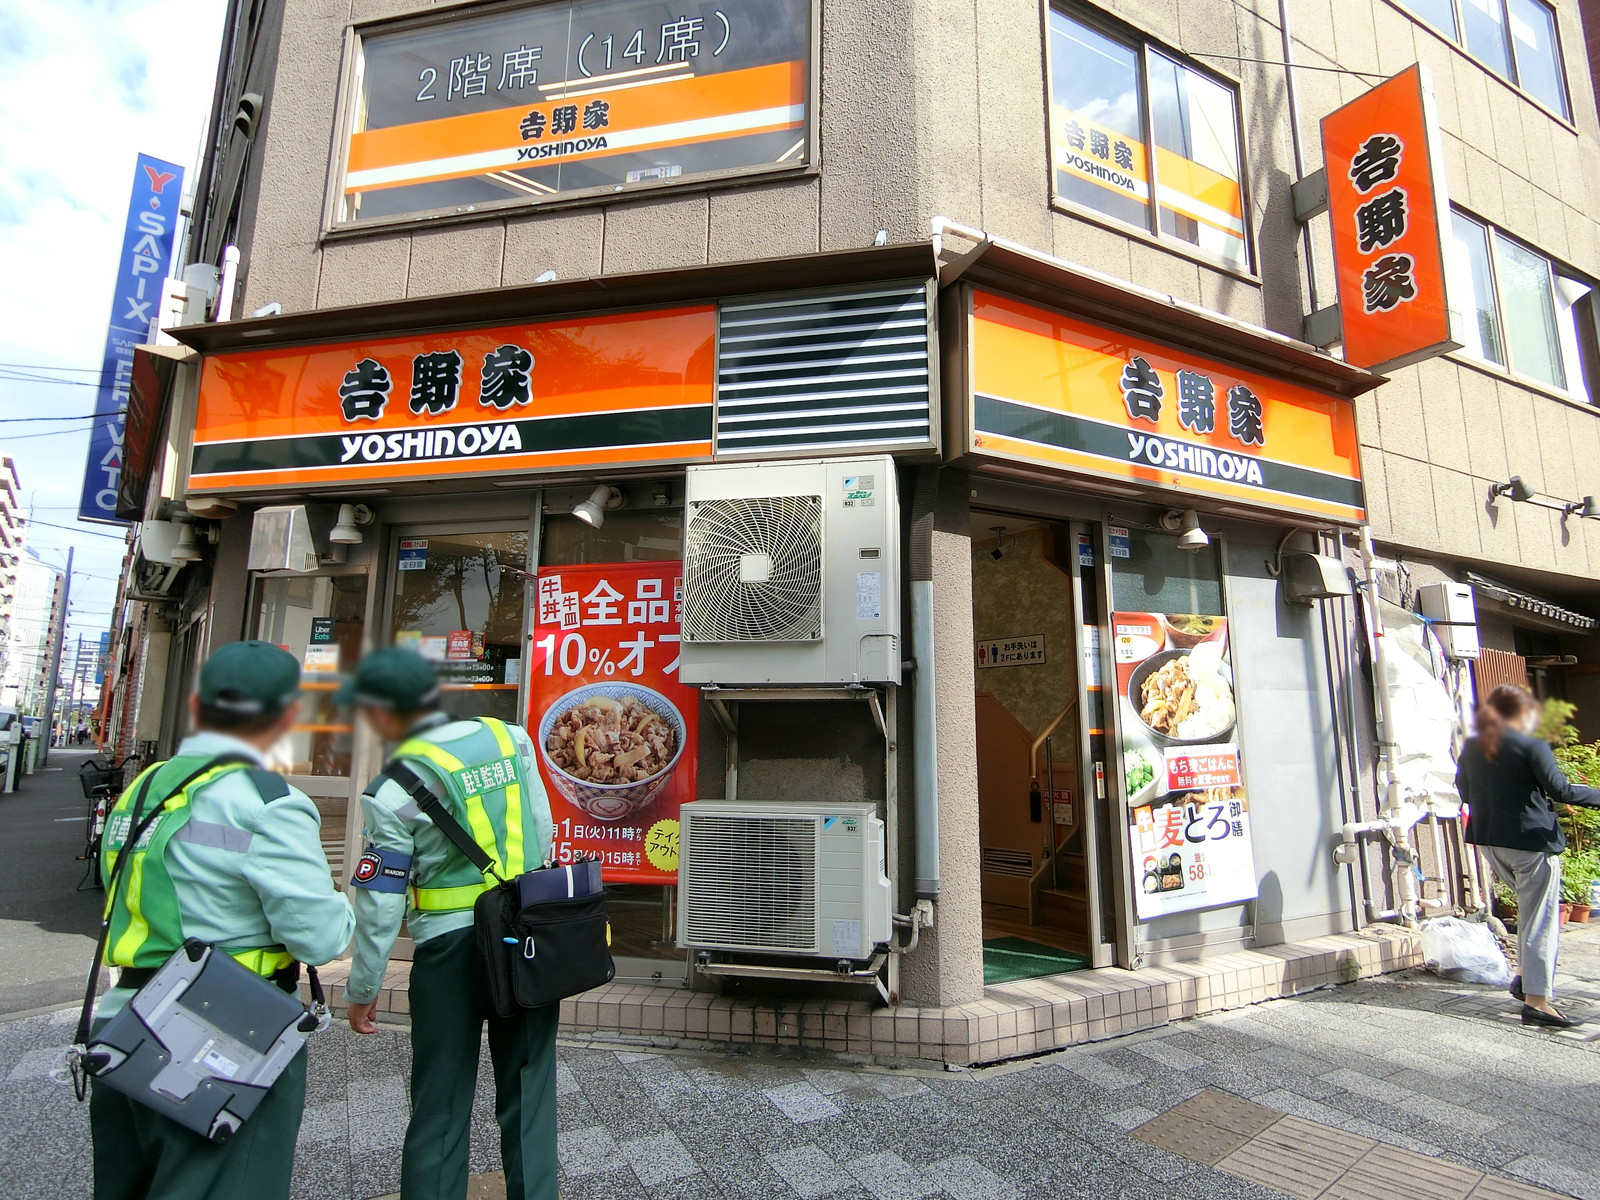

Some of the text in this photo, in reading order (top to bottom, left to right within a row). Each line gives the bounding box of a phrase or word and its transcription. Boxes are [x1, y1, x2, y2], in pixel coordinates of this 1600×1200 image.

[517, 136, 609, 162] YOSHINOYA
[1066, 152, 1135, 191] YOSHINOYA
[124, 210, 167, 324] SAPIX
[341, 424, 522, 463] YOSHINOYA
[1126, 433, 1263, 485] YOSHINOYA
[541, 578, 560, 620] 牛丼
[562, 595, 578, 626] 牛皿
[582, 579, 670, 626] 全品
[1000, 650, 1044, 662] 2Fにあります
[1004, 640, 1038, 652] お手洗いは
[1169, 757, 1235, 774] もち麦ごはんに
[1157, 805, 1231, 849] 麦とろ
[384, 868, 406, 877] WARDEN
